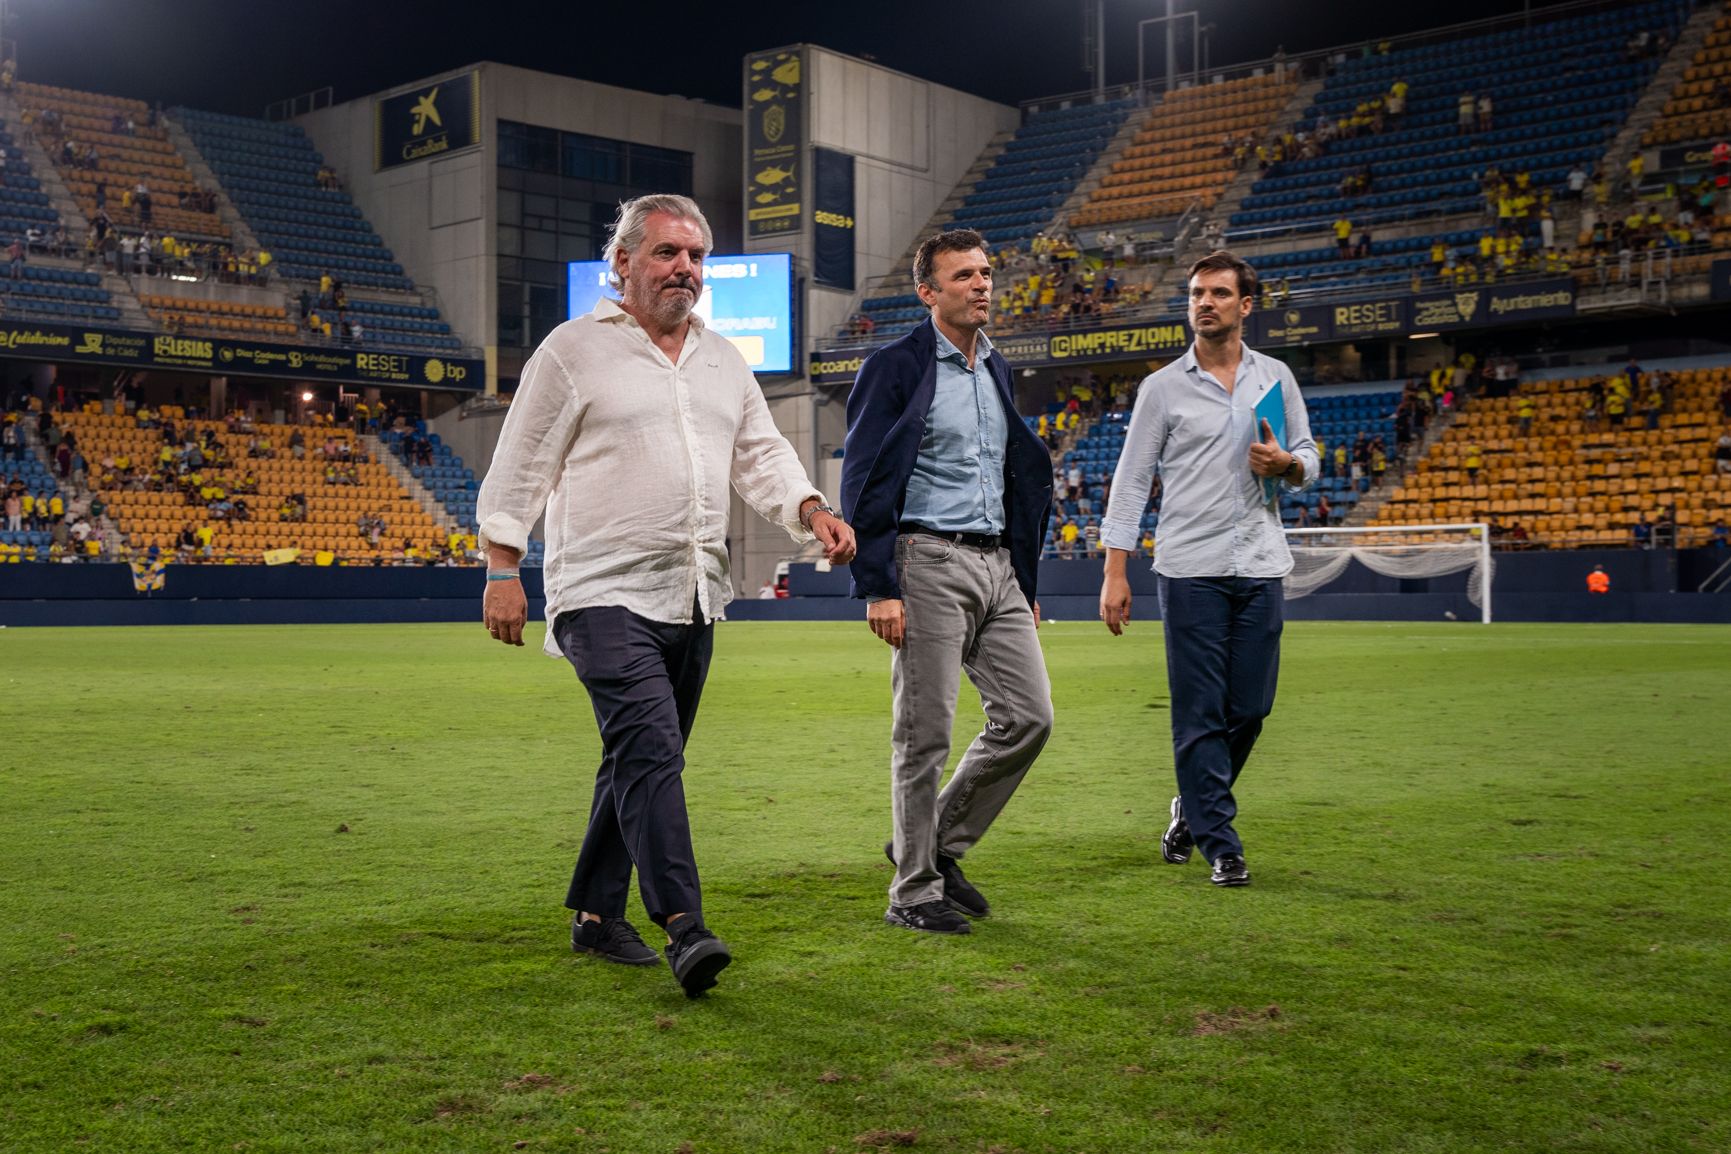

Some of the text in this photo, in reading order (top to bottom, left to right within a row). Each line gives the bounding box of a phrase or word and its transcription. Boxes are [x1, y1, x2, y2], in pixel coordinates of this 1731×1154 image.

[1335, 300, 1400, 325] RESET
[1489, 289, 1572, 314] Ayuntamiento
[356, 353, 410, 372] RESET
[447, 363, 466, 382] bp
